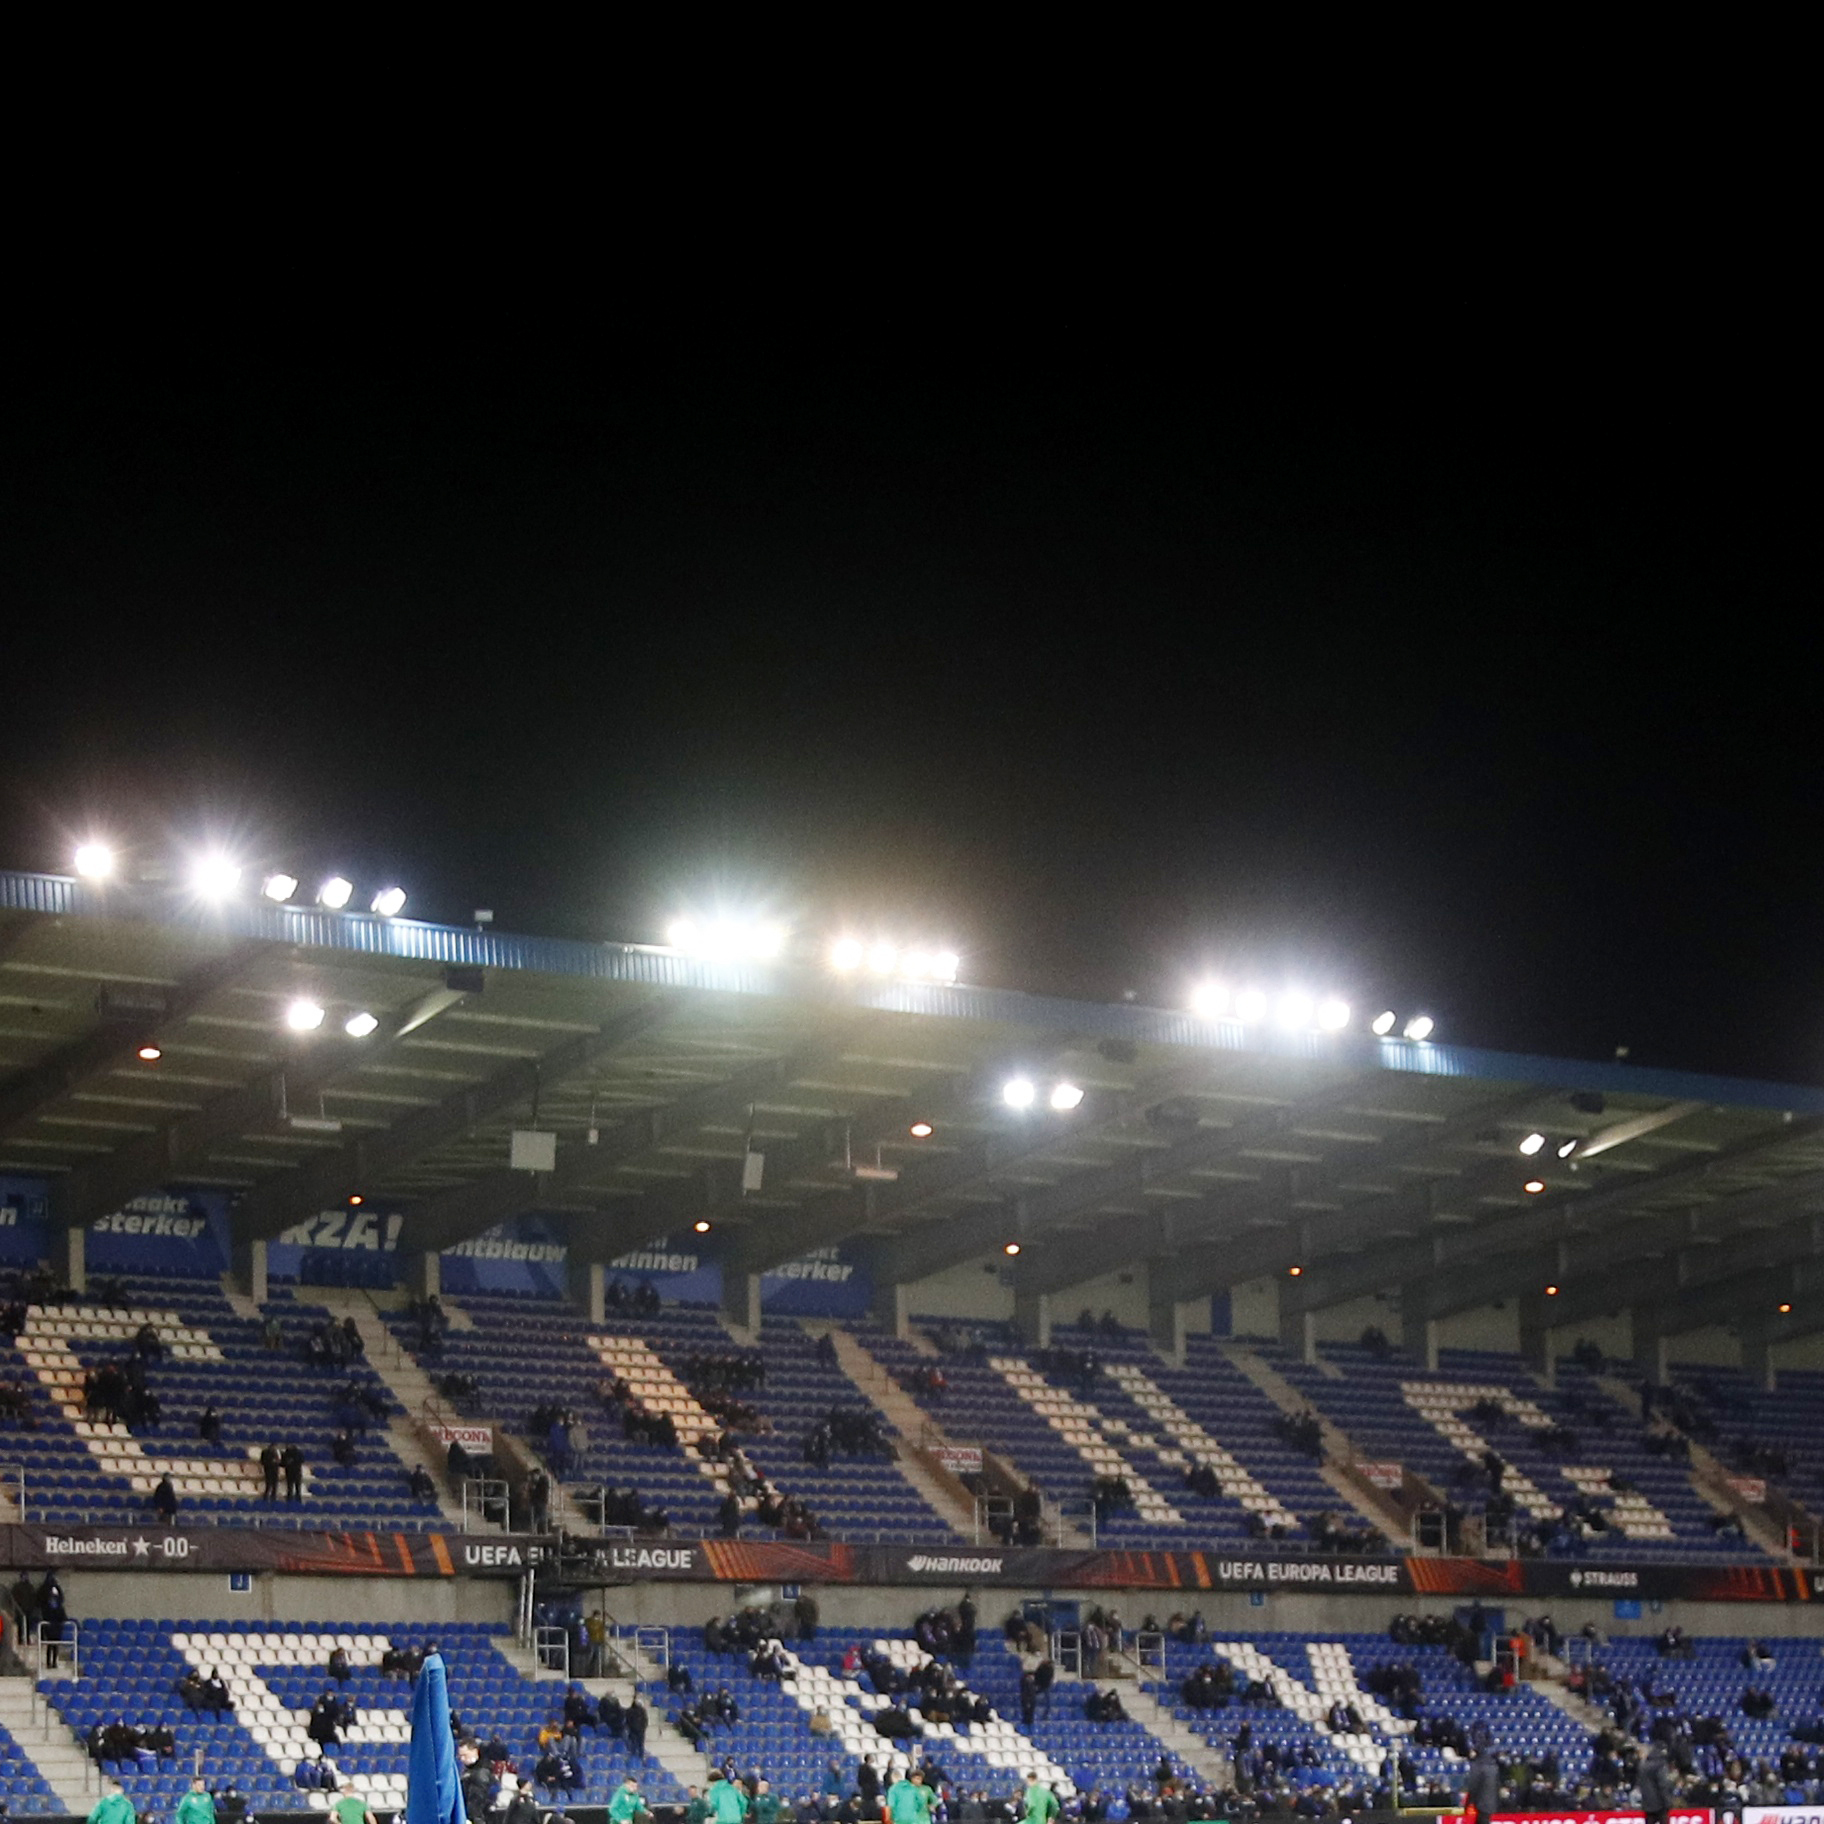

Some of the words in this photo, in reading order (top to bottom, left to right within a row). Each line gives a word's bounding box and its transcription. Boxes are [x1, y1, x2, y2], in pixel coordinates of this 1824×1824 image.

[93, 1211, 205, 1238] sterker
[46, 1535, 127, 1555] Heineken
[464, 1545, 521, 1566] UEFA
[613, 1548, 692, 1568] LEAGUE
[1220, 1561, 1264, 1580] UEFA
[1268, 1562, 1331, 1581] EUROPA
[1335, 1564, 1398, 1583] LEAGUE
[1584, 1571, 1638, 1586] STRAUSS
